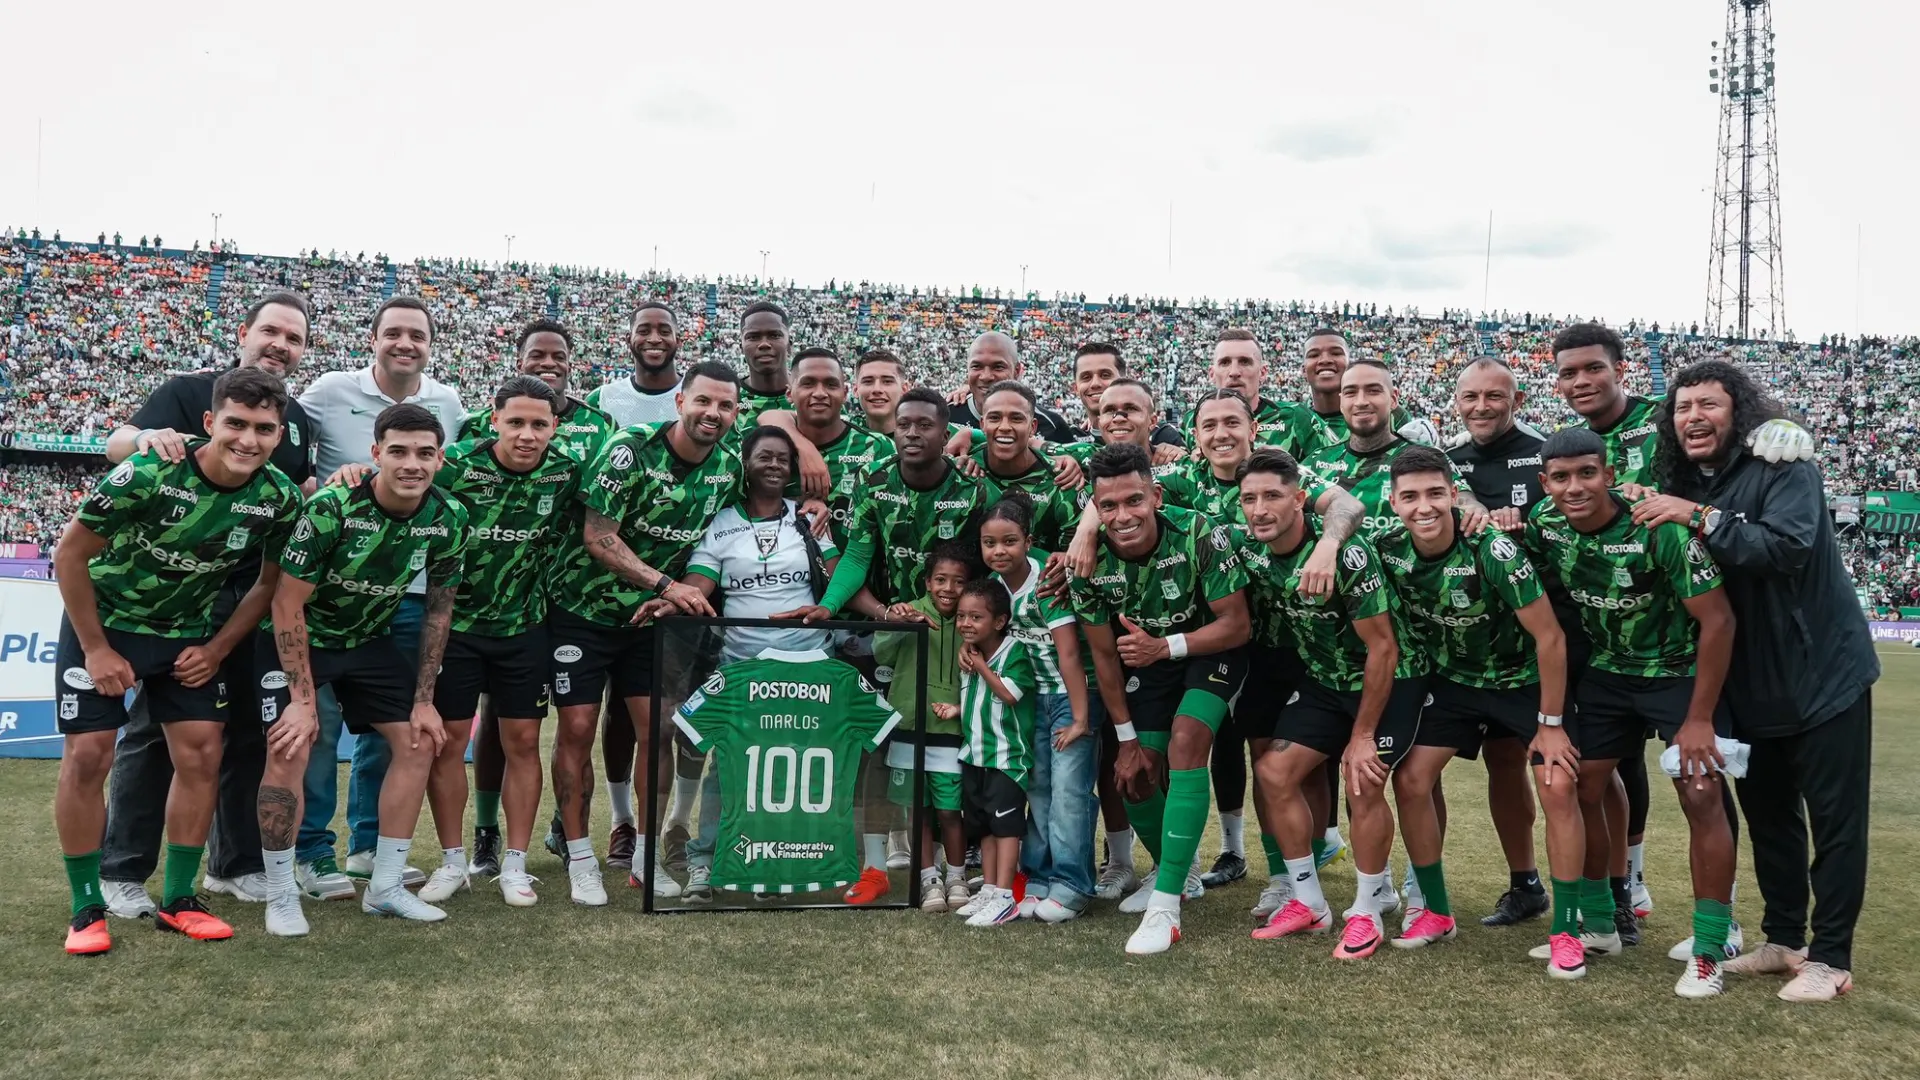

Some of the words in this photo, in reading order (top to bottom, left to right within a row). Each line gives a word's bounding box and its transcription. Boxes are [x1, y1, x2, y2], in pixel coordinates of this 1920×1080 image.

[610, 445, 634, 469] MG
[481, 486, 495, 498] 30
[601, 474, 622, 494] trii
[172, 505, 187, 519] 19
[356, 536, 370, 548] 22
[1491, 537, 1517, 561] MG
[135, 532, 239, 573] betsson
[286, 546, 308, 566] trii
[1343, 545, 1367, 570] MG
[1112, 587, 1124, 597] 16
[1360, 573, 1382, 593] trii
[1570, 590, 1655, 610] etsson
[1217, 662, 1229, 675] 16
[749, 681, 831, 704] POSTOBON
[760, 714, 819, 730] MARLOS
[1379, 736, 1394, 748] 20
[745, 745, 834, 814] 100
[745, 841, 778, 864] JFK
[778, 842, 834, 852] Cooperativa
[778, 851, 824, 859] Financiera
